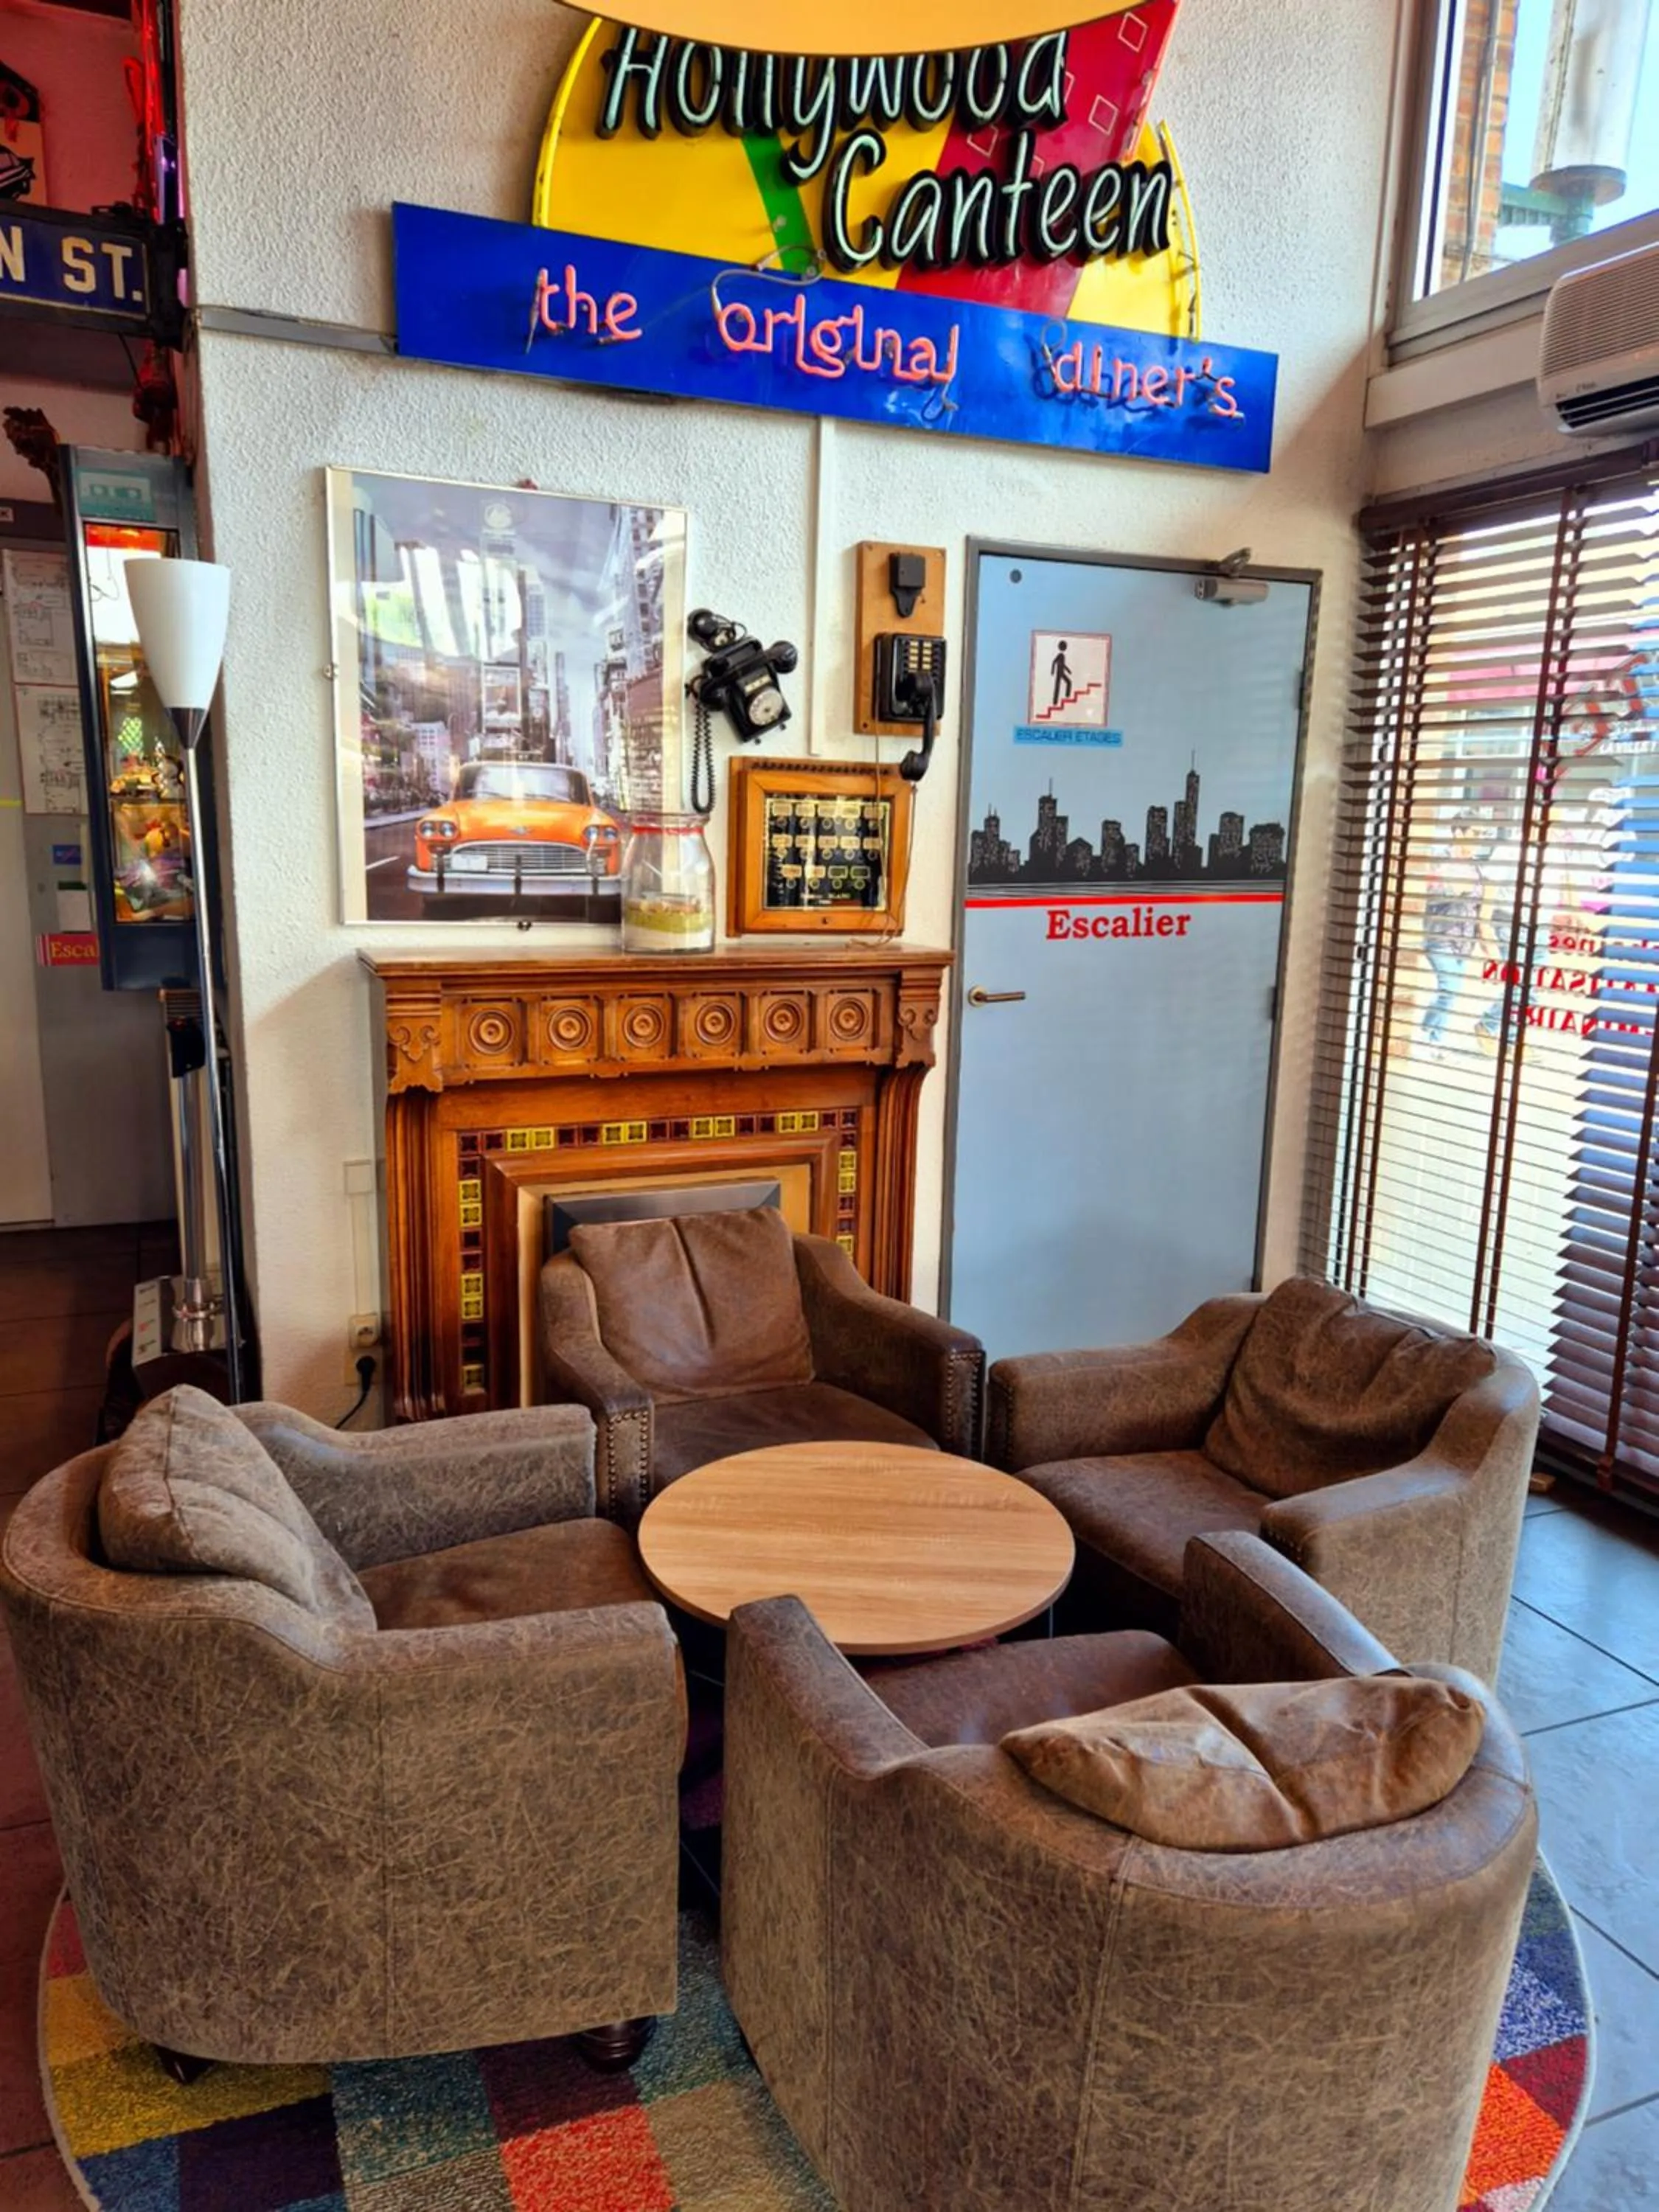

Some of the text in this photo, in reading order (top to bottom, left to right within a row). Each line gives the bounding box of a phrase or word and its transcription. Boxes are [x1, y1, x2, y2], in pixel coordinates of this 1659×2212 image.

[823, 128, 1173, 272] Canteen
[61, 235, 143, 302] ST.
[538, 264, 1243, 418] the original diner's
[1046, 906, 1192, 940] Escalier
